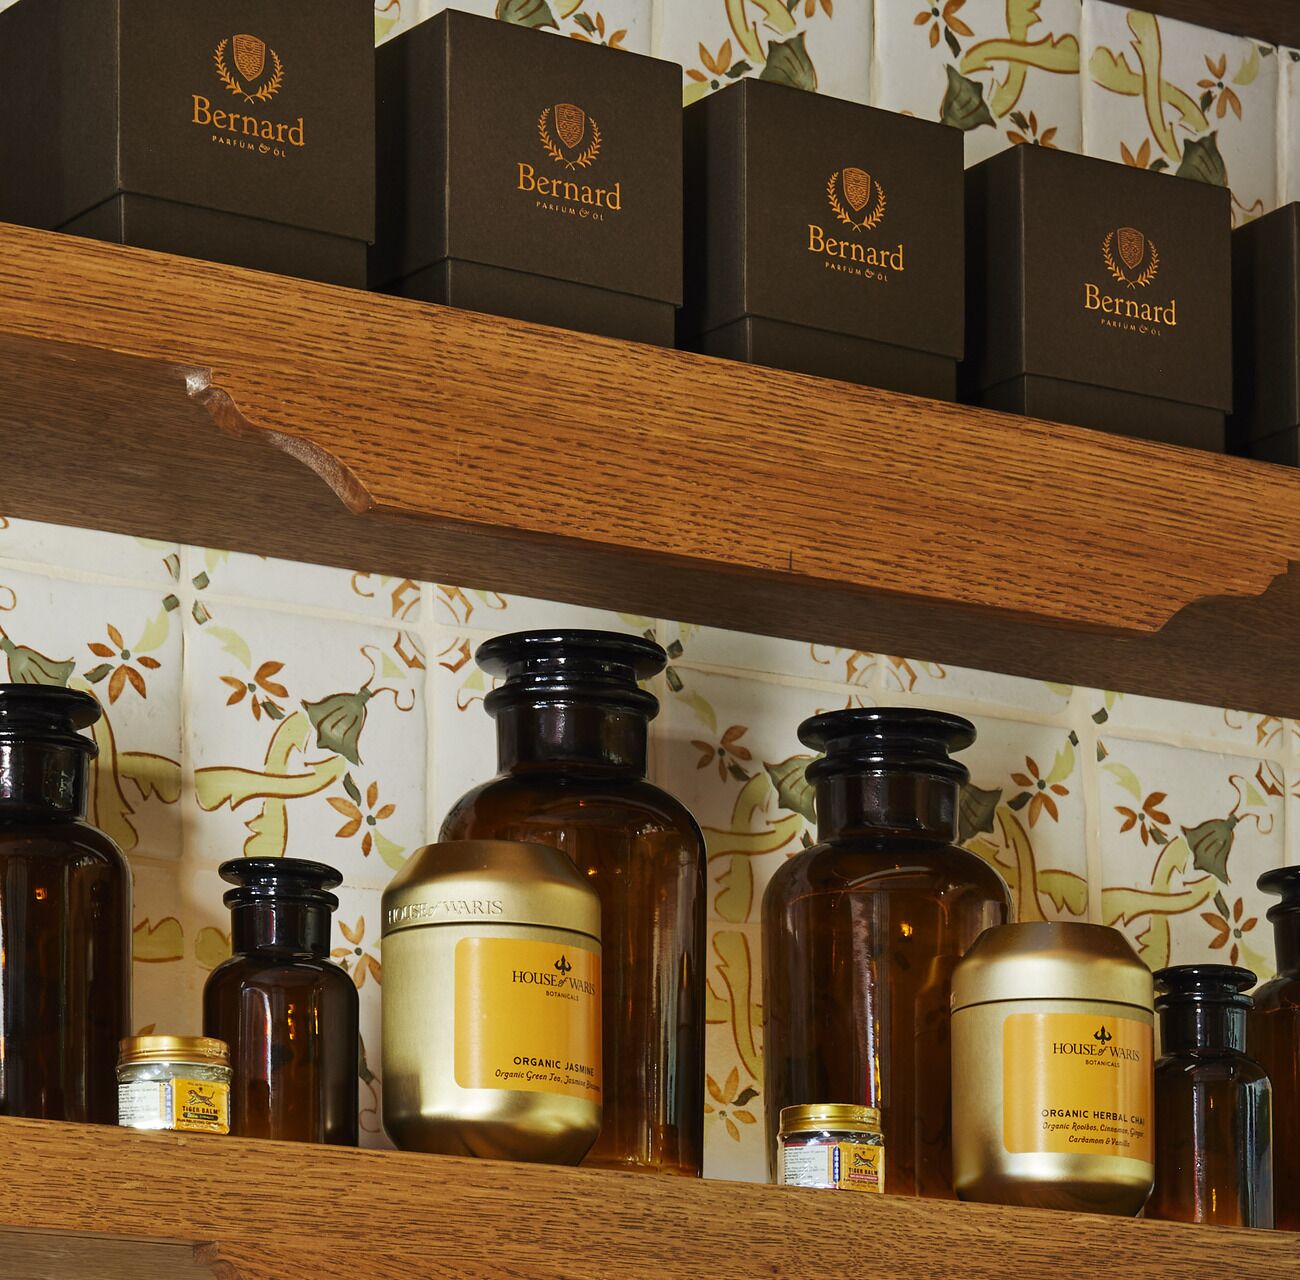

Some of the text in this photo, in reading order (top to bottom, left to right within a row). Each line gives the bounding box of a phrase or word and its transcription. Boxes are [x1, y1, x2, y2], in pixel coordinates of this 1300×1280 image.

[191, 94, 305, 147] Bernard
[517, 162, 621, 210] Bernard
[808, 224, 904, 271] Bernard
[1084, 283, 1177, 326] Bernard
[388, 902, 427, 925] HOUSE
[443, 899, 504, 915] WARIS
[512, 970, 596, 996] HOUSE of WARIS
[545, 990, 579, 1001] BOTANICALS
[1053, 1043, 1140, 1062] HOUSE of WARIS
[513, 1056, 594, 1077] ORGANIC JASMINE
[1085, 1059, 1120, 1068] BOTANICALS
[495, 1068, 525, 1080] Organic
[526, 1071, 547, 1081] Green
[182, 1105, 218, 1114] TIGER BALM
[1041, 1109, 1145, 1126] ORGANIC HERBAL CHAI
[1042, 1122, 1070, 1132] Organic
[1068, 1135, 1104, 1145] Cardamom
